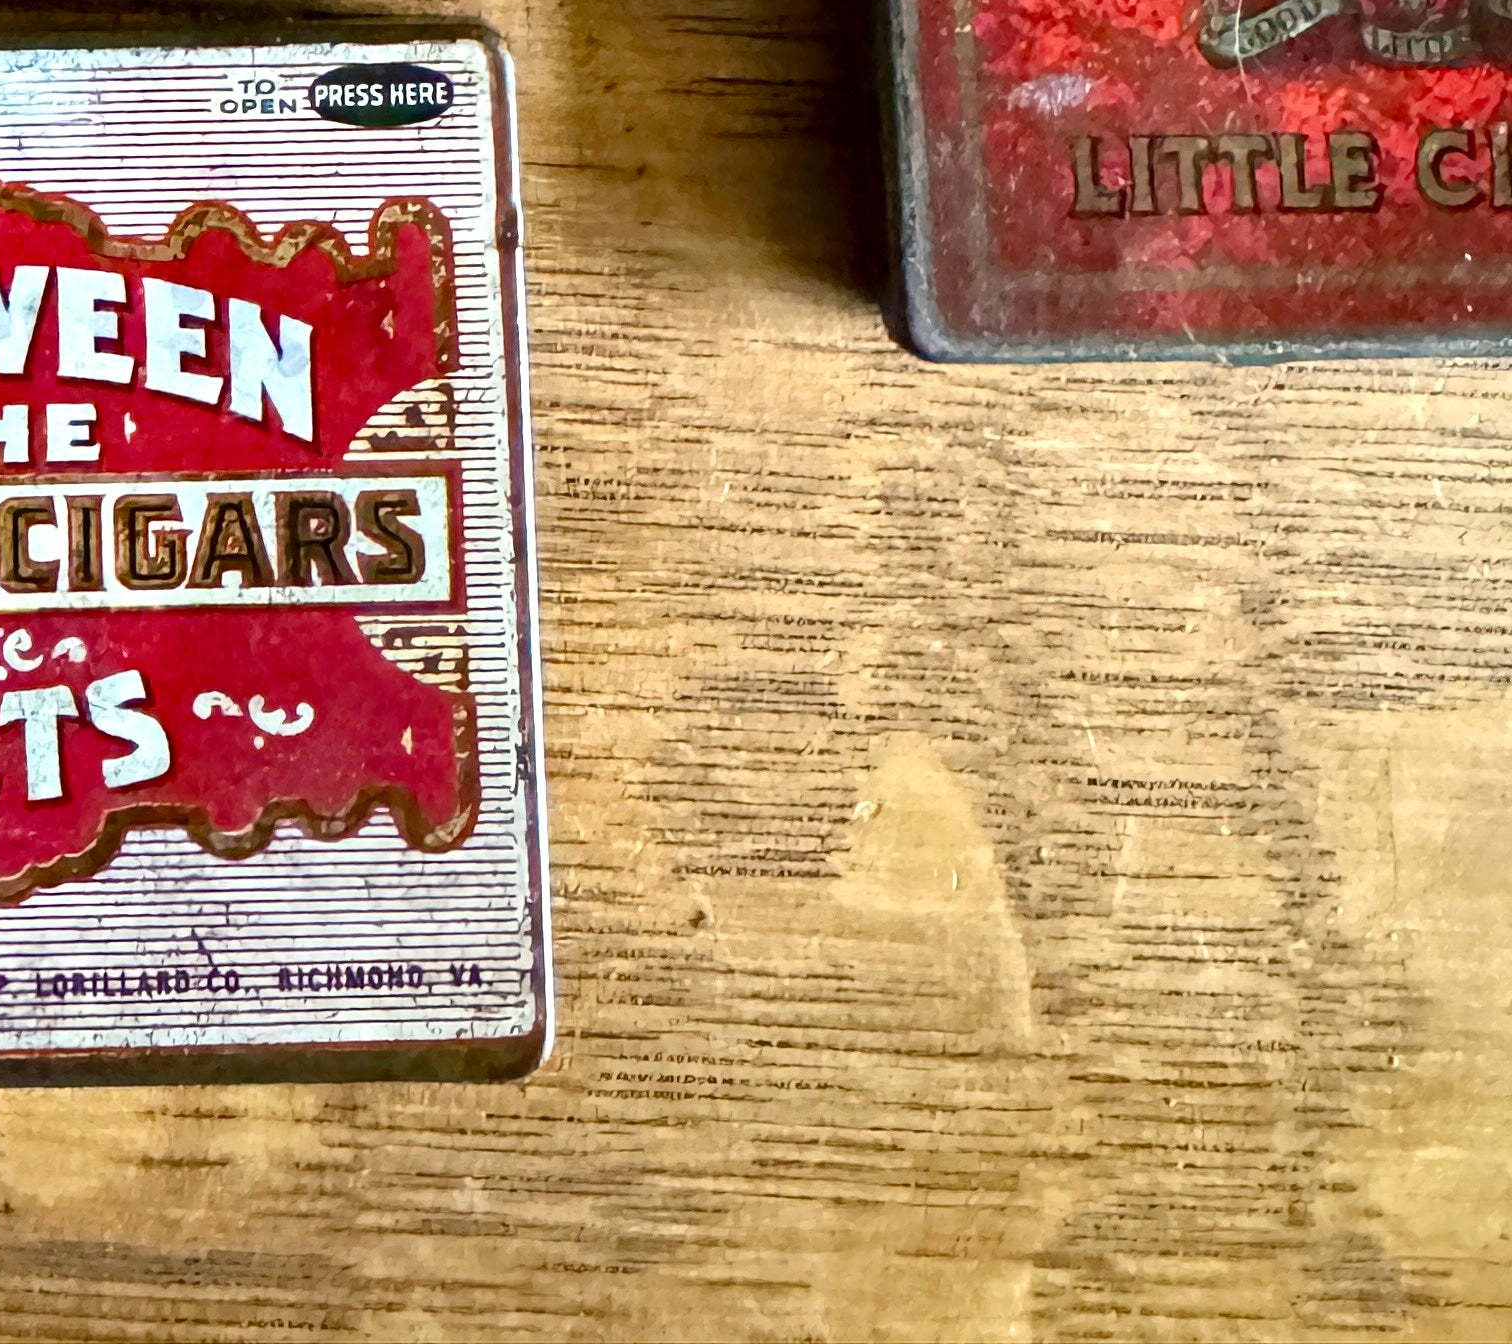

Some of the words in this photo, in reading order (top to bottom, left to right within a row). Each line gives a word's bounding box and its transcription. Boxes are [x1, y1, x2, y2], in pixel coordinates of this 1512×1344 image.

[237, 79, 276, 96] TO
[314, 84, 385, 108] PRESS
[389, 82, 450, 106] HERE
[219, 98, 298, 115] OPEN
[1072, 132, 1382, 217] LITTLE
[35, 969, 189, 998] LORILLARD
